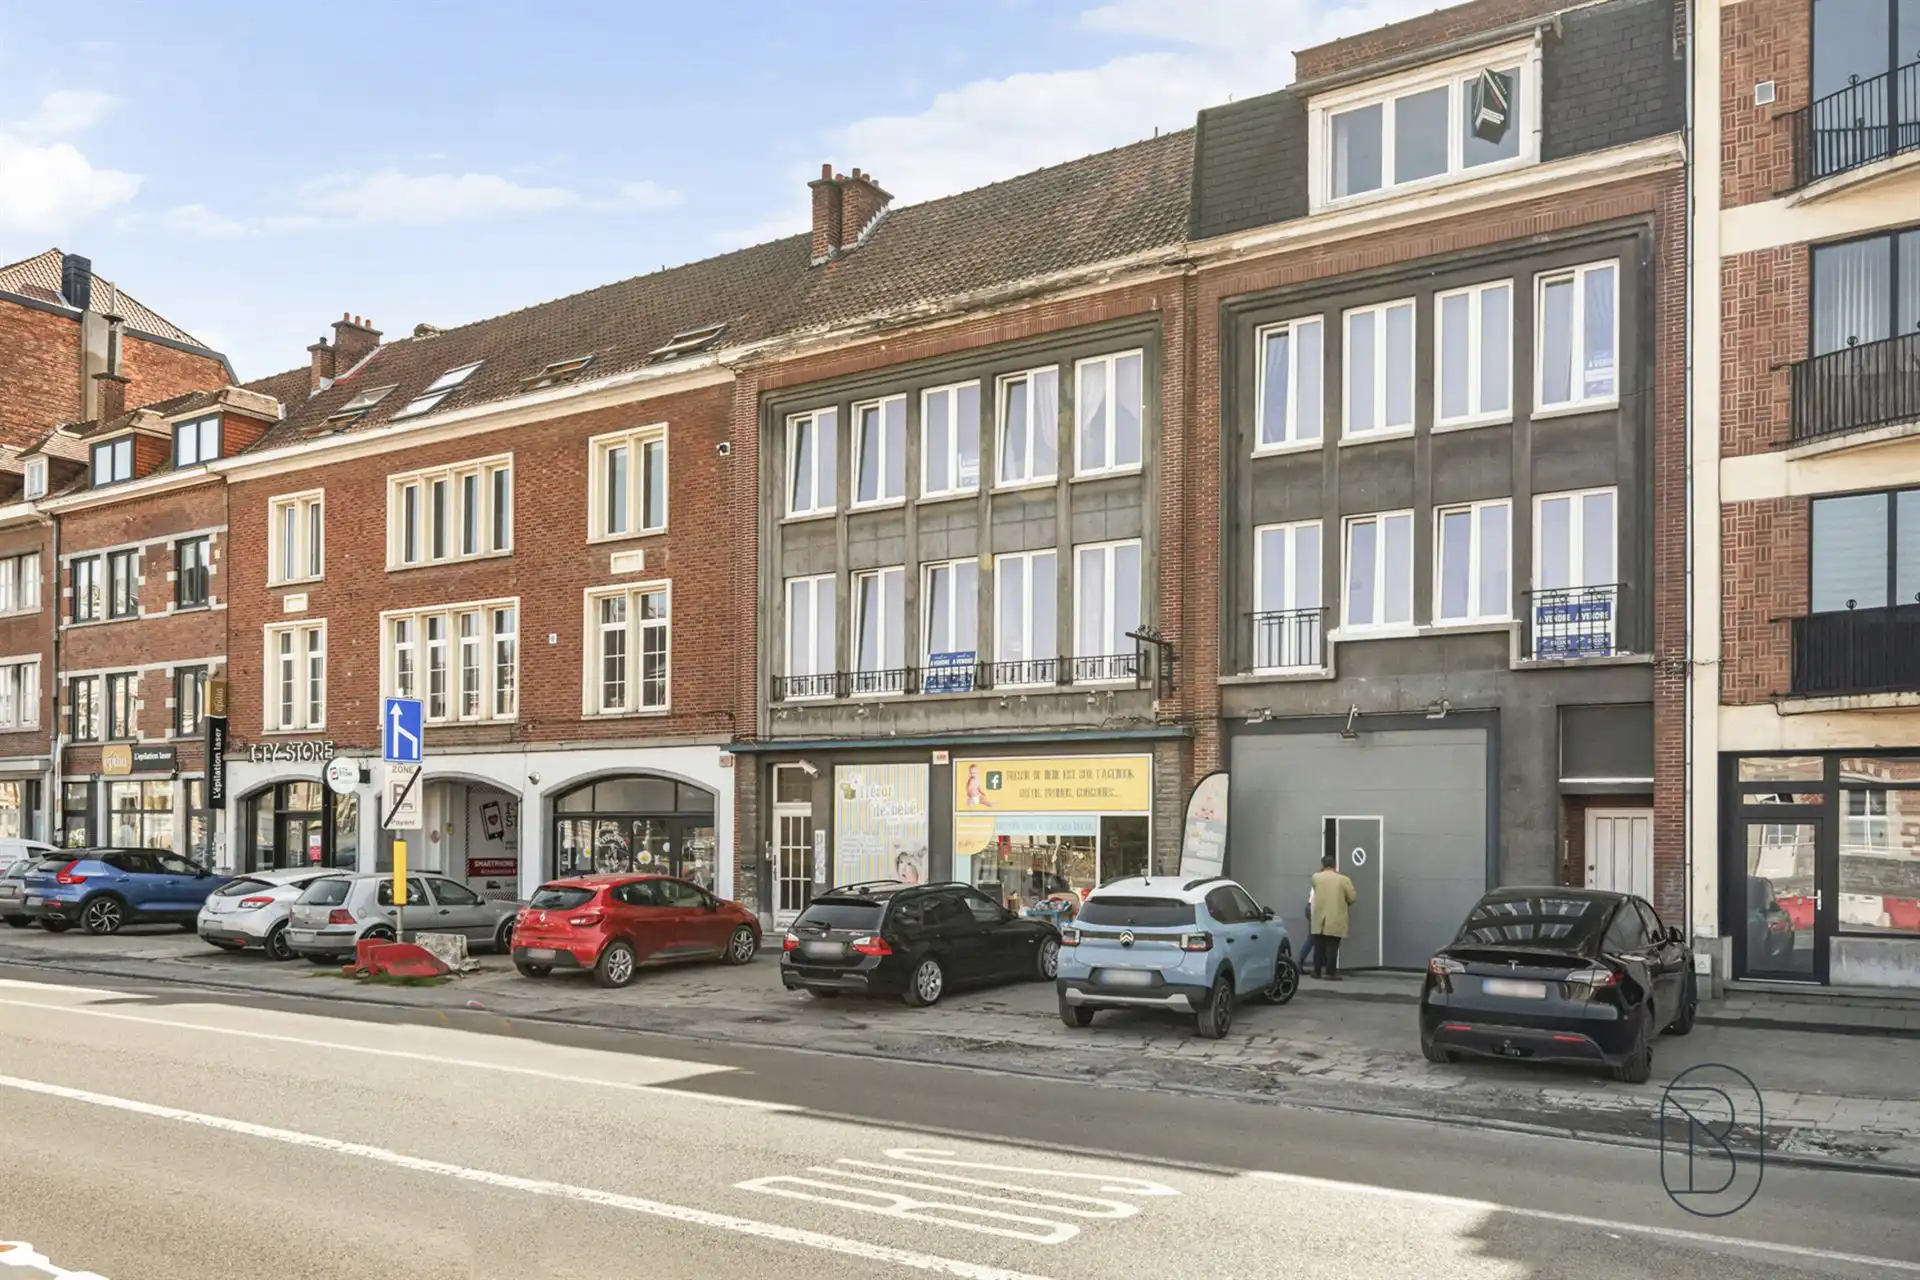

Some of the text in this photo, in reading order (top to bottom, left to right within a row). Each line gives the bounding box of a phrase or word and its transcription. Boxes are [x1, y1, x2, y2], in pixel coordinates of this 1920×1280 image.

[285, 739, 335, 762] STORE
[213, 728, 223, 799] L'épilation laser
[391, 765, 415, 774] ZONE
